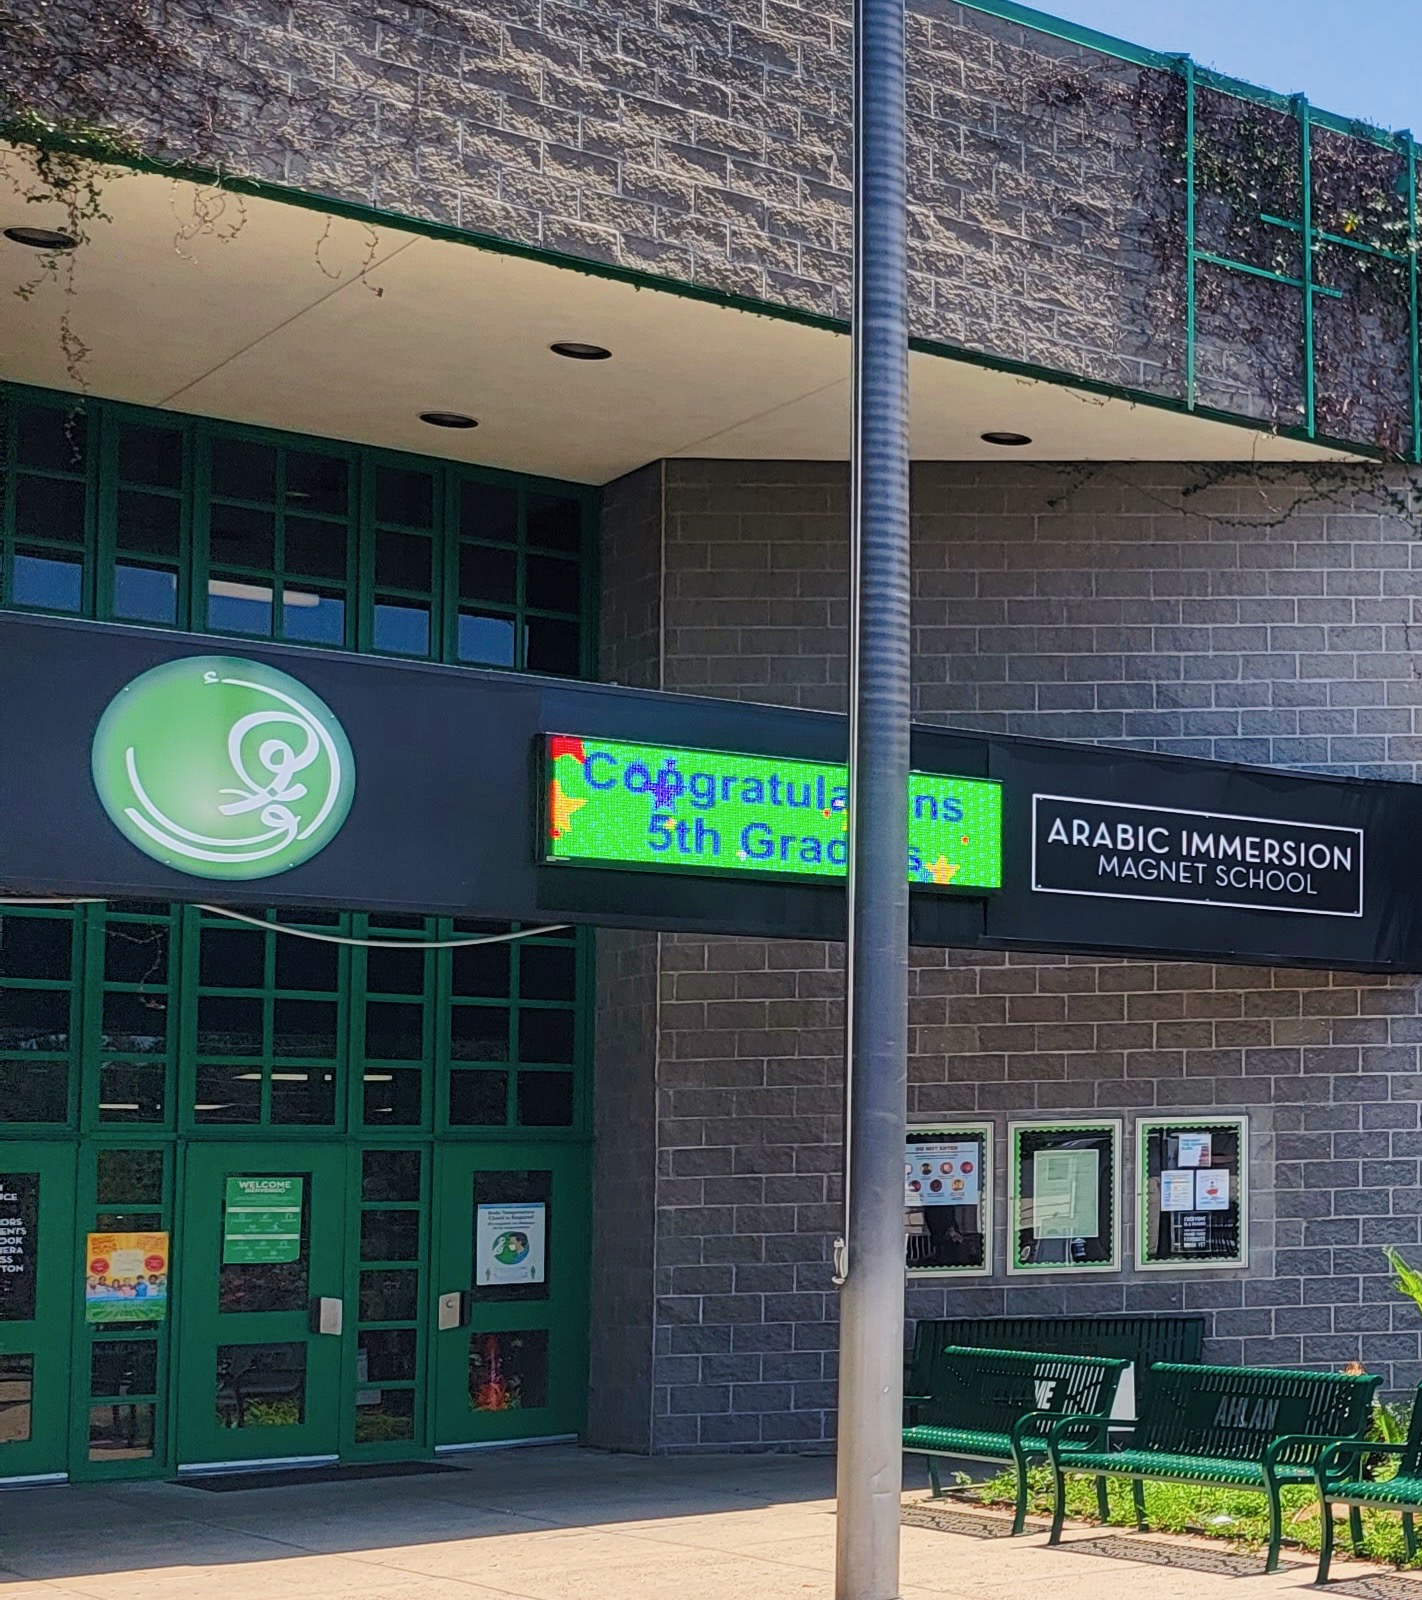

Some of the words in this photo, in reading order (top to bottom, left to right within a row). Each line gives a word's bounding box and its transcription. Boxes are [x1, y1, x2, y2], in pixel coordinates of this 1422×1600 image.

[648, 814, 721, 856] 5th
[1047, 817, 1170, 854] ARABIC
[1181, 830, 1352, 873] IMMERSION
[1098, 854, 1207, 884] MAGNET
[1215, 865, 1318, 895] SCHOOL
[238, 1181, 292, 1189] WELCOME
[0, 1217, 23, 1226] ORS
[0, 1246, 24, 1254] ERA
[0, 1265, 24, 1273] TON
[1213, 1396, 1280, 1430] AHLAN
